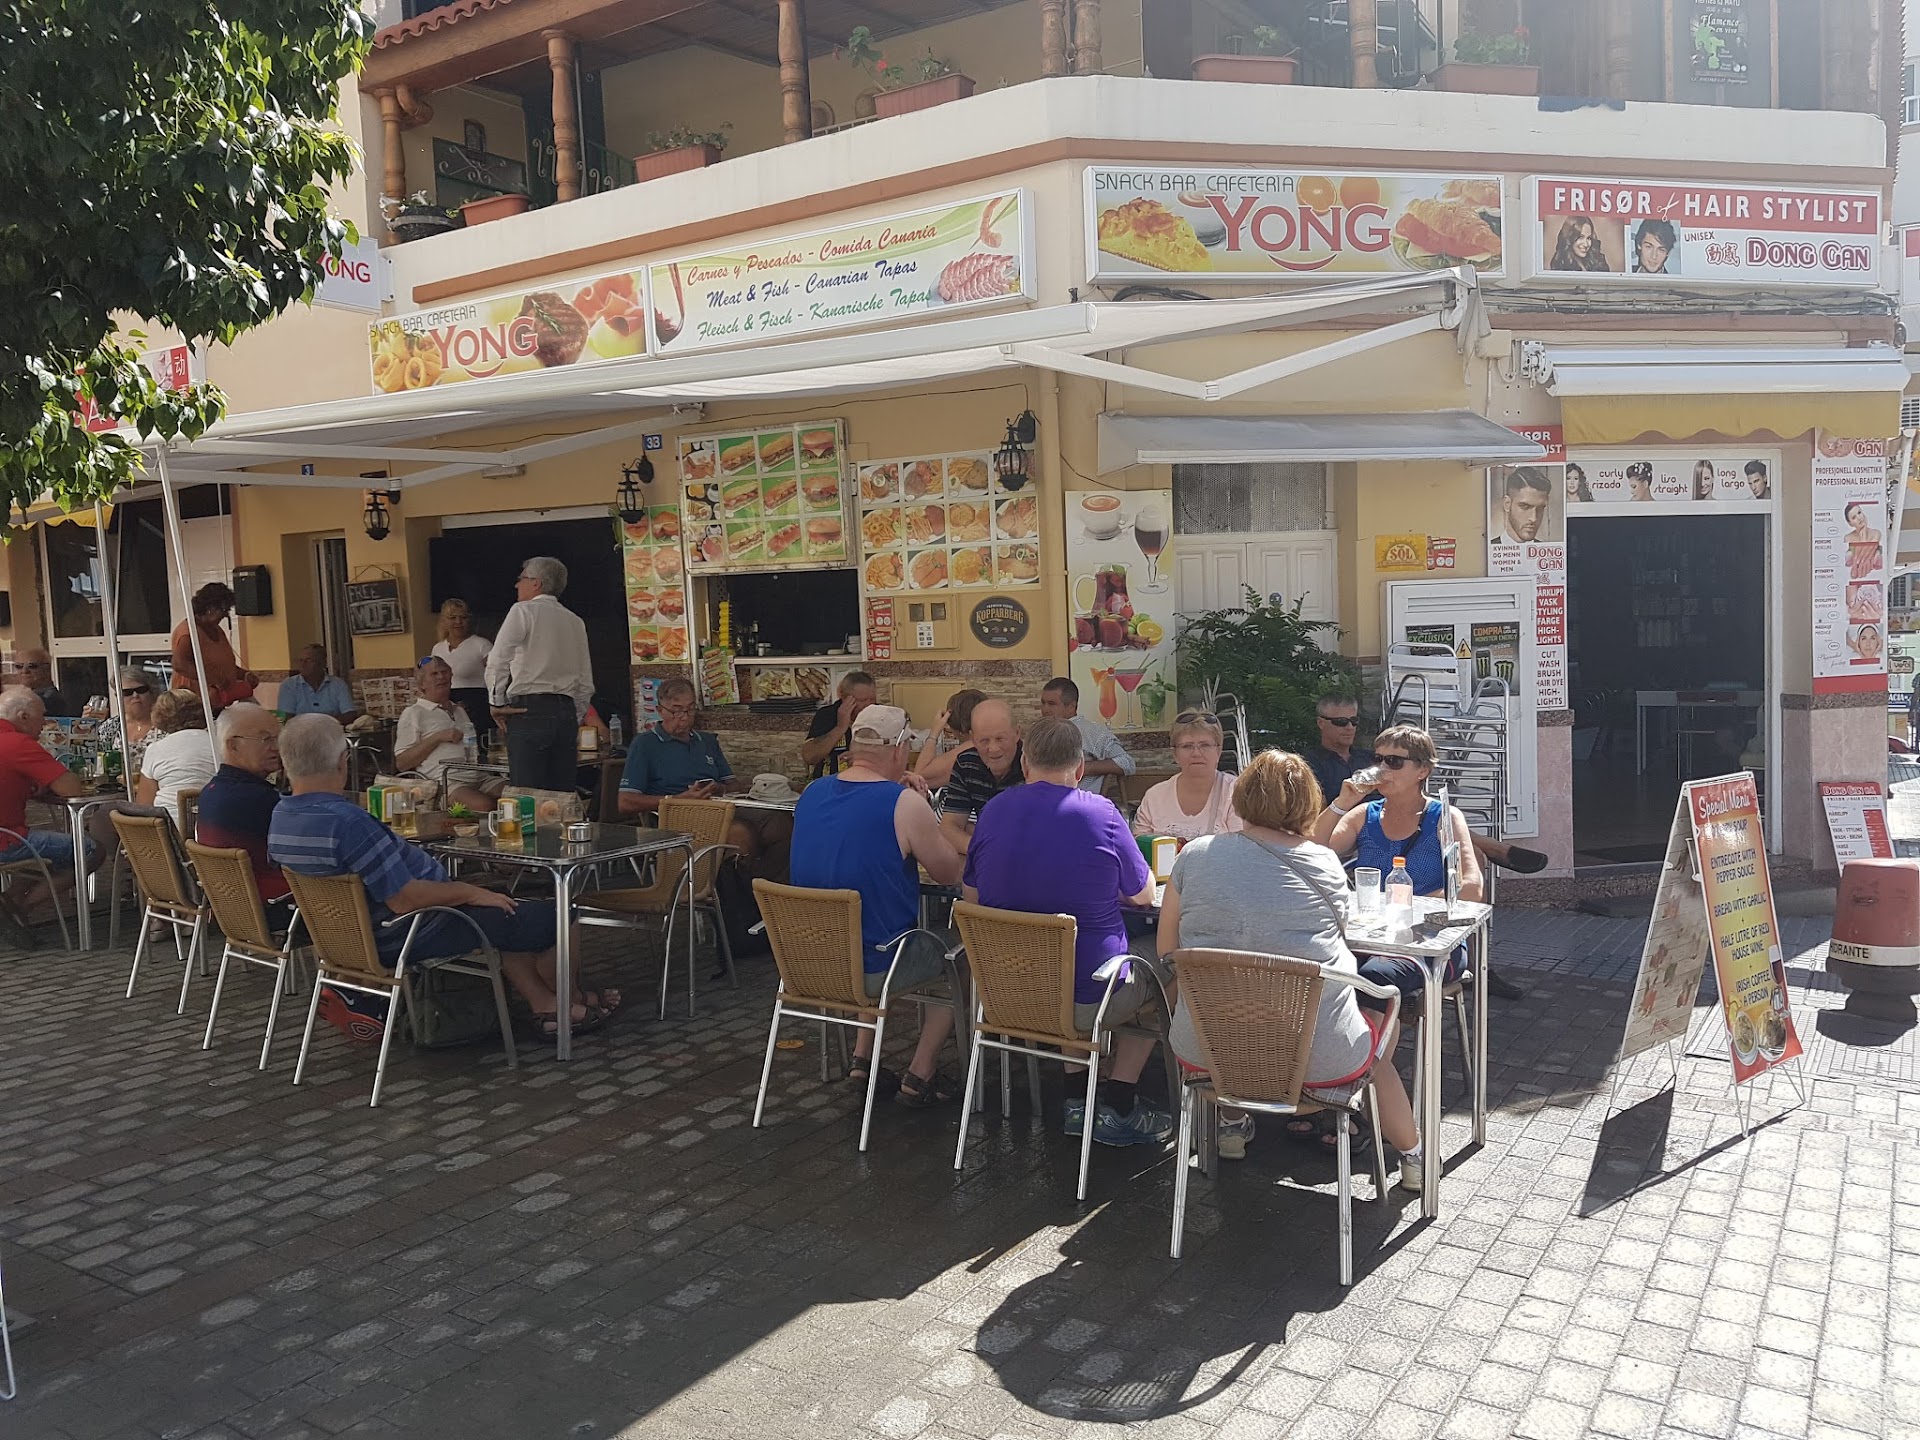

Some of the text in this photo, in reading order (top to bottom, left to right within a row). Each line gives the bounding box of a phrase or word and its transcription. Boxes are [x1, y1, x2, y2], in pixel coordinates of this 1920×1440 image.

[1700, 13, 1740, 27] Flamenco
[1095, 173, 1154, 191] SNACK
[1160, 174, 1197, 191] BAR
[1554, 187, 1868, 223] FRISØR HAIR STYLIST
[1204, 195, 1392, 253] YONG
[1684, 231, 1715, 242] UNISEX
[687, 265, 729, 288] Carnes
[733, 265, 743, 281] y
[746, 251, 804, 276] Pescados
[819, 238, 873, 262] Comida
[878, 224, 938, 250] Canaria
[1746, 237, 1871, 271] DONG GAN
[706, 288, 742, 309] Meat
[746, 283, 756, 302] &
[760, 280, 790, 304] Fish
[806, 270, 870, 295] Canarian
[874, 258, 918, 282] Tapas
[697, 319, 740, 342] Fleisch
[743, 313, 754, 331] &
[759, 307, 792, 331] Fisch
[809, 295, 884, 321] Kanarische
[889, 286, 933, 310] Tapas
[370, 321, 400, 339] SNACK
[403, 315, 424, 332] BAR
[428, 316, 539, 370] YONG
[1599, 468, 1624, 479] curly
[1717, 468, 1737, 479] long
[1853, 466, 1883, 474] KOSMETIKK
[1592, 479, 1621, 489] rizado
[1660, 474, 1677, 483] liso
[1721, 479, 1745, 490] largo
[1815, 477, 1883, 486] PROFESSIONAL BEAUTY
[1653, 483, 1688, 495] straight
[1390, 548, 1413, 561] SOL
[1526, 545, 1564, 559] DONG
[1538, 558, 1564, 571] GAN
[348, 584, 381, 603] FREE
[1536, 588, 1564, 596] ÅRKLIPP
[1538, 598, 1558, 606] VASK
[976, 607, 1024, 625] KOPPARBERG
[1536, 607, 1563, 616] TYLING
[1537, 617, 1560, 625] FARGE
[1473, 626, 1503, 637] COMPRA
[1537, 627, 1560, 635] HIGH-
[1407, 633, 1454, 643] EXCLUSIVO
[1541, 650, 1557, 658] CUT
[1538, 660, 1560, 668] WASH
[1537, 669, 1562, 677] BRUSH
[1551, 678, 1564, 686] DYE
[1538, 688, 1560, 696] HIGH-
[1536, 697, 1562, 705] LIGHTS
[1698, 789, 1752, 822] Special Menu
[1710, 847, 1757, 870] ENTRECOTE WITH
[1716, 868, 1737, 884] PEPPER
[1713, 891, 1767, 918] BREAD WITH GARLIC
[1720, 922, 1770, 949] HALF LITRE OF RED
[1731, 940, 1765, 961] HOUSE WINE
[1736, 969, 1771, 993] IRISH COFFEE
[1748, 986, 1769, 1005] PERSON
